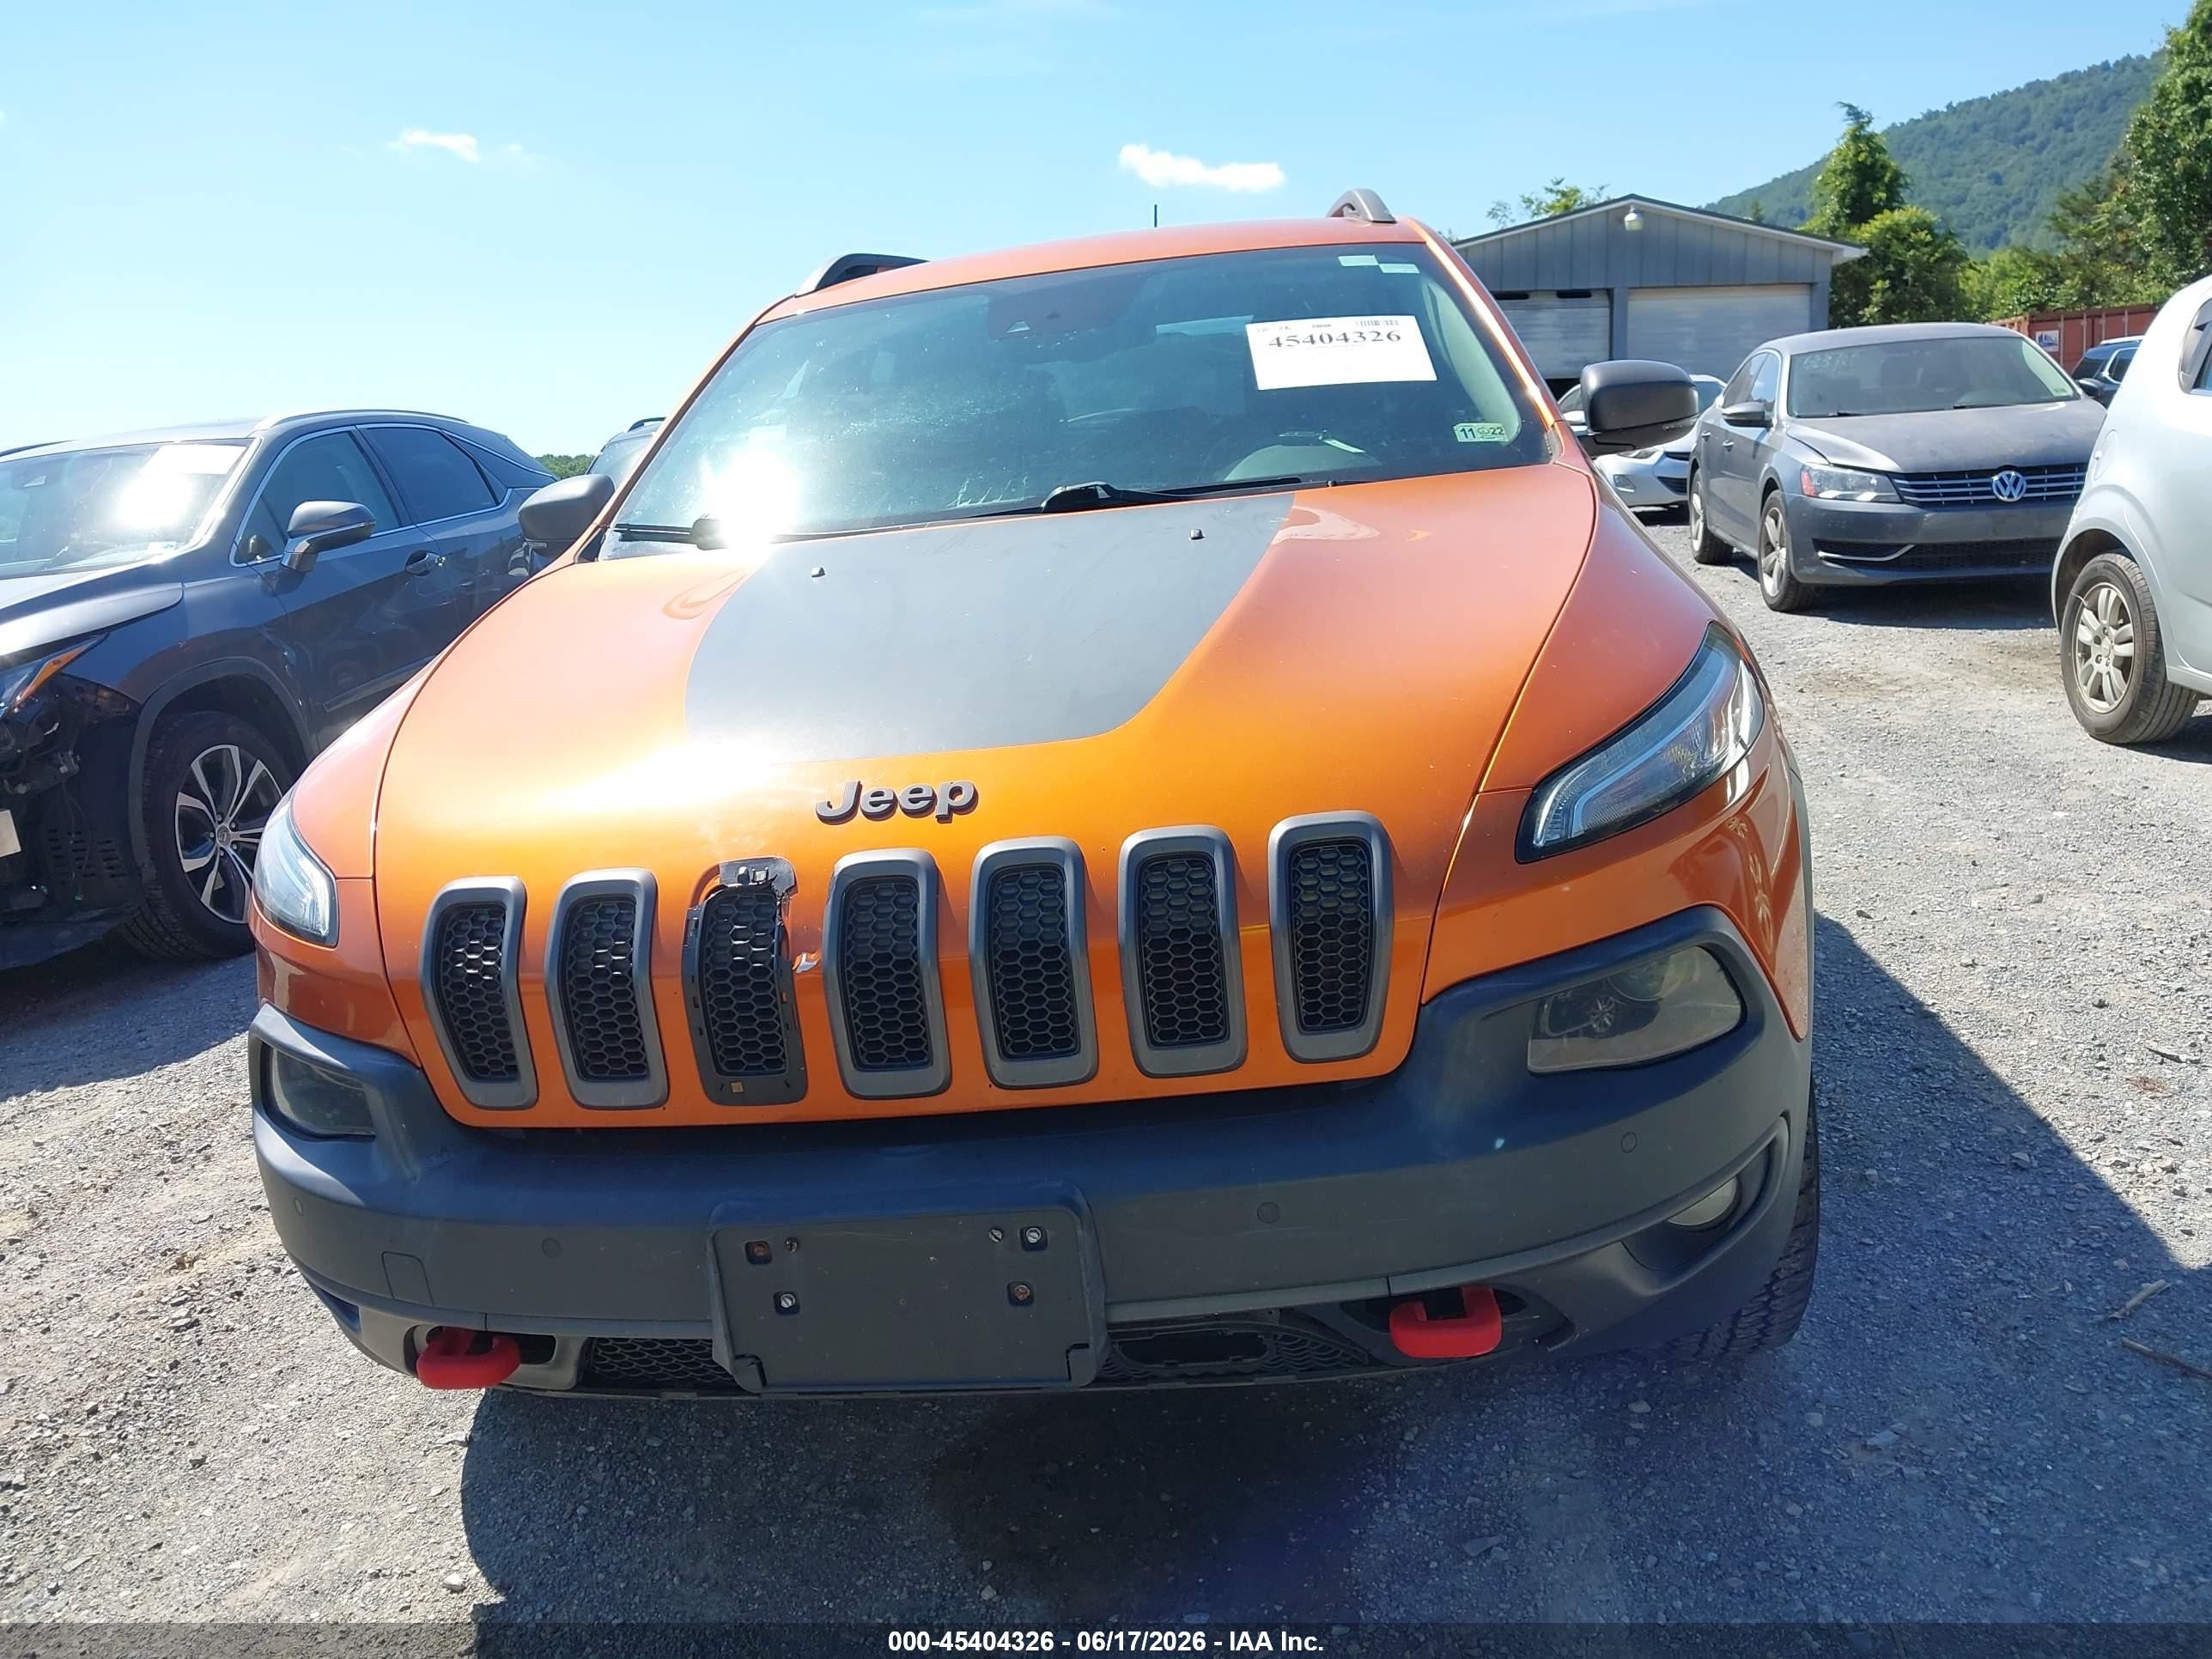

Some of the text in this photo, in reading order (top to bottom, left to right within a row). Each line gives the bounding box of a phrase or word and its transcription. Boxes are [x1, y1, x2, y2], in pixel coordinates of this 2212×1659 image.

[1268, 330, 1401, 348] 45404326
[1460, 427, 1505, 439] 11 22
[1992, 471, 2027, 502] VW
[816, 780, 978, 825] Jeep
